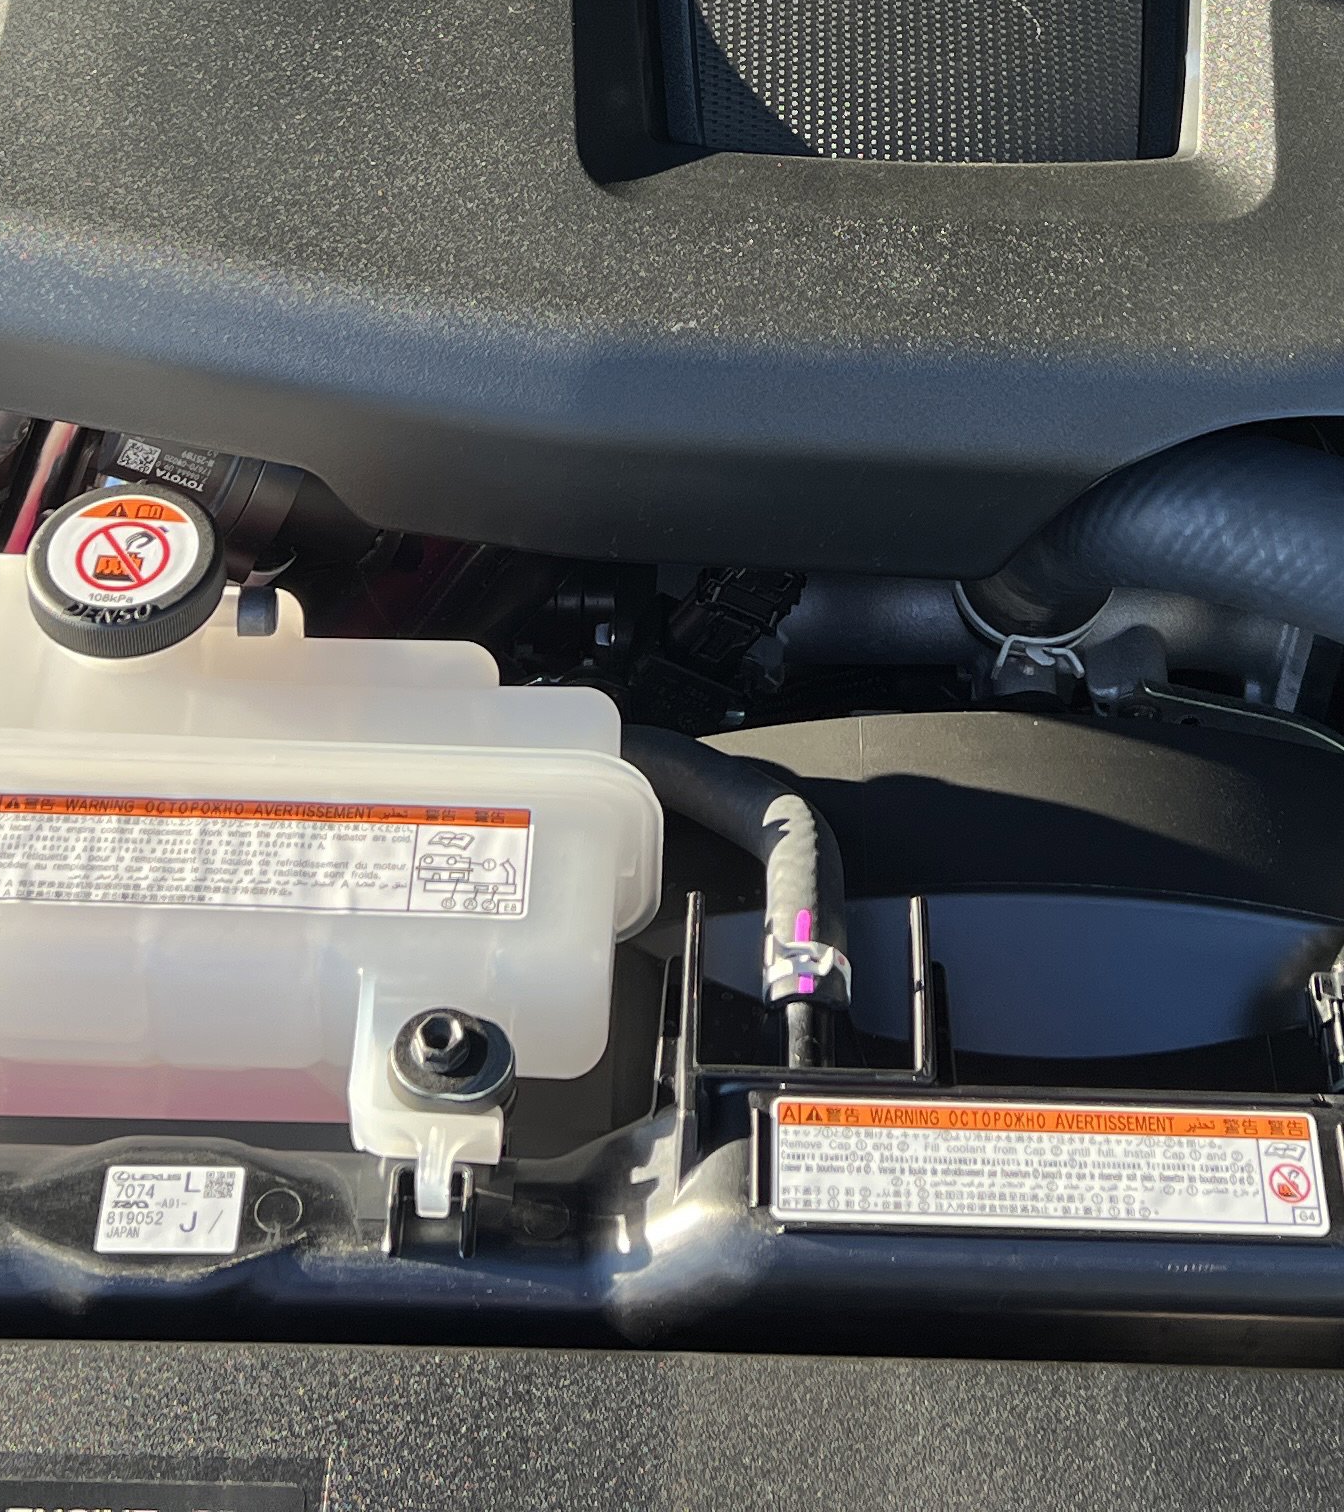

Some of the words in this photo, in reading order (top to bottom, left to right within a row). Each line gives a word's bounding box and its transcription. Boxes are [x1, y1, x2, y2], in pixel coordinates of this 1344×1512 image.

[155, 468, 204, 492] TOYOTA
[60, 603, 153, 624] DENSO
[63, 798, 135, 812] WARNING
[143, 800, 245, 816] ОСТОРОЖНО
[252, 803, 373, 819] AVERTISSEMENT
[256, 830, 271, 838] the
[74, 852, 82, 861] A
[201, 856, 216, 865] du
[257, 858, 271, 867] de
[354, 861, 368, 870] du
[782, 1105, 796, 1121] A
[869, 1107, 939, 1125] WARNING
[948, 1110, 1046, 1128] ОСТОРОЖНО
[1054, 1112, 1175, 1132] AVERTISSEMENT
[1183, 1117, 1216, 1133] تحذير
[1222, 1118, 1258, 1134] 警告
[1267, 1119, 1303, 1136] 警告
[781, 1137, 822, 1150] Remove
[828, 1139, 851, 1151] Cap
[871, 1140, 892, 1152] and
[923, 1141, 939, 1153] Fill
[945, 1142, 986, 1154] coolant
[993, 1143, 1017, 1155] from
[1023, 1144, 1045, 1156] Cap
[1066, 1145, 1090, 1157] until
[1123, 1147, 1156, 1159] Install
[1162, 1148, 1185, 1160] Cap
[1205, 1149, 1227, 1161] and
[131, 1173, 182, 1181] LEXUS
[184, 1171, 201, 1193] L
[116, 1184, 156, 1199] 7074
[106, 1210, 164, 1226] 819052
[179, 1210, 198, 1233] J
[1297, 1209, 1316, 1221] G4
[106, 1226, 140, 1239] JAPAN
